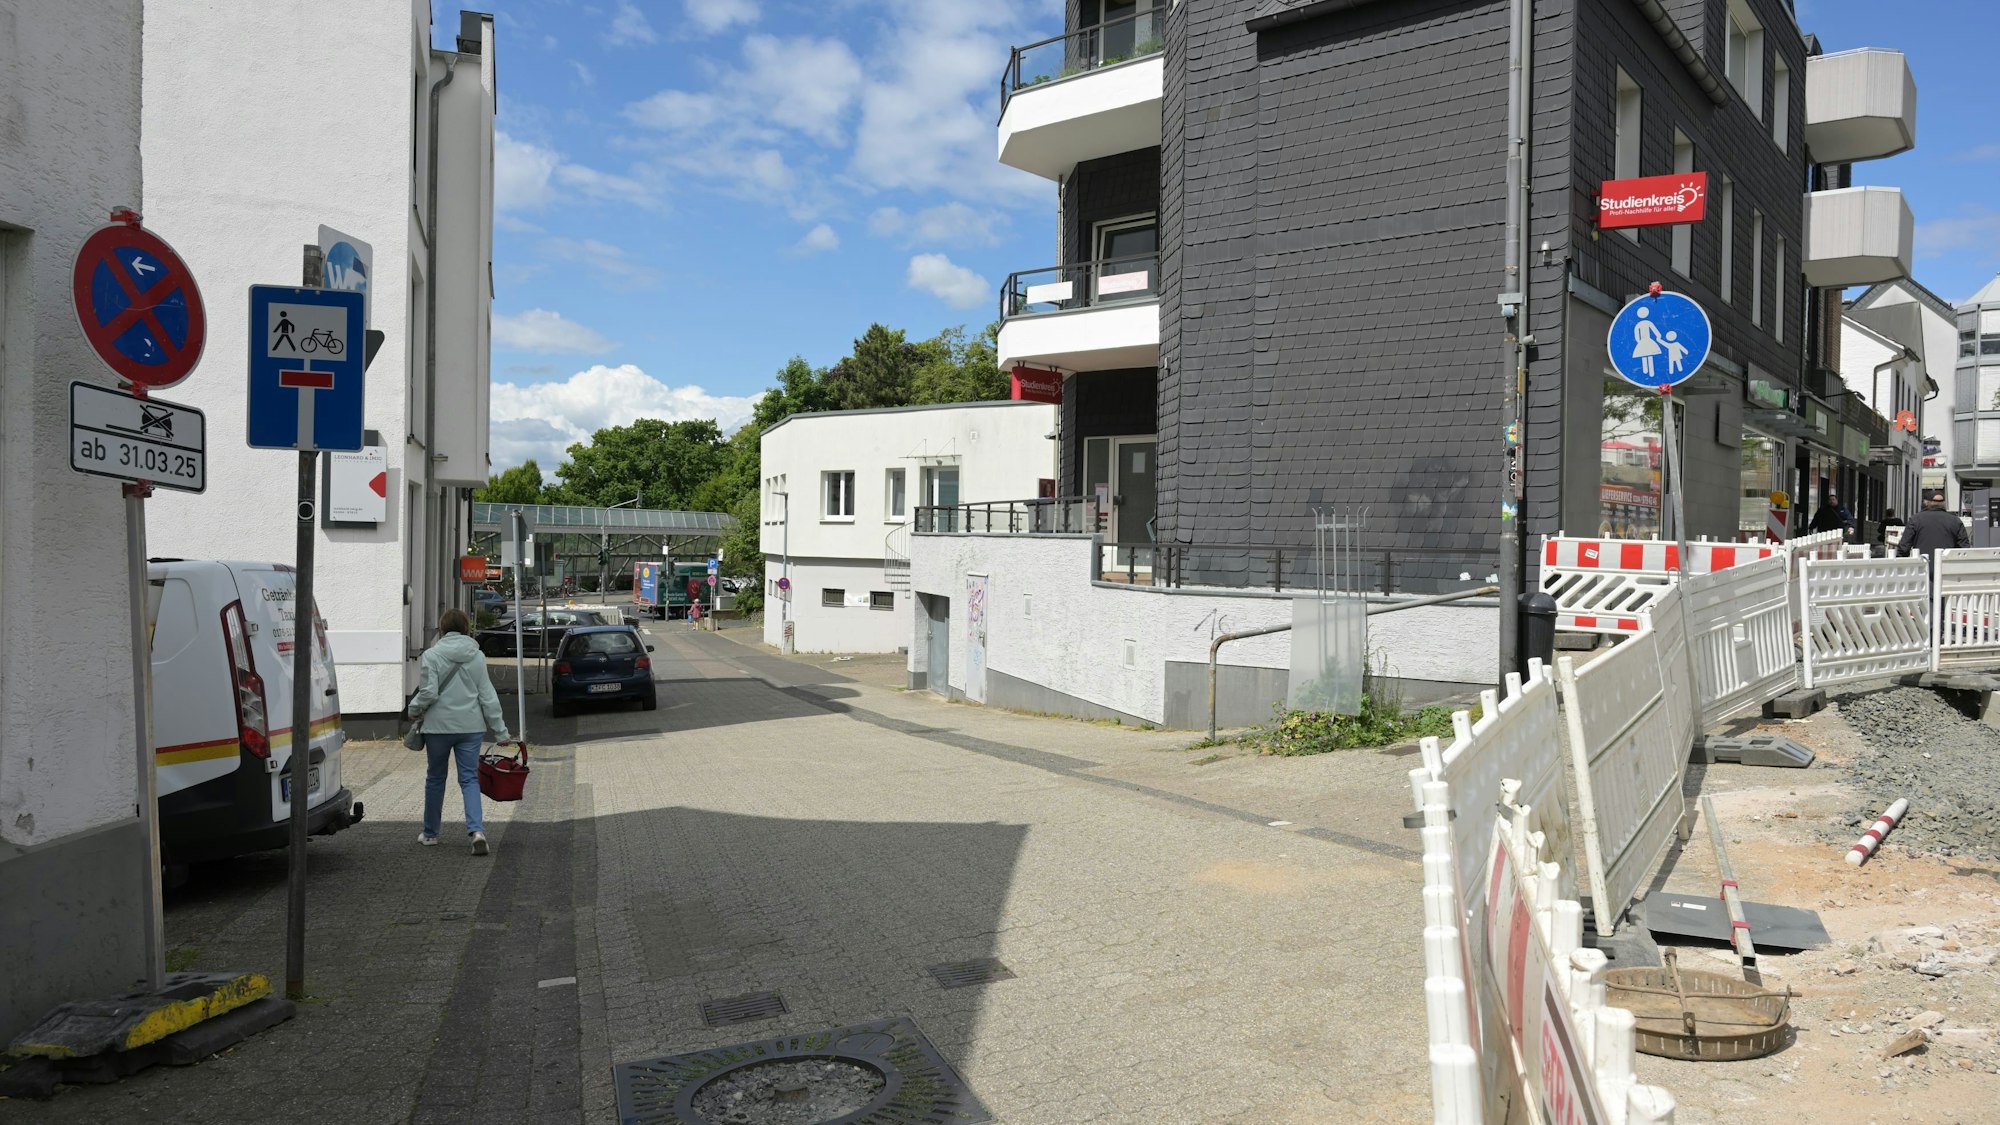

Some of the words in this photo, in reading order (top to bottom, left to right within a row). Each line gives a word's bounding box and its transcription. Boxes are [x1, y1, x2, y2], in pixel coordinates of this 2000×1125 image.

[1600, 192, 1685, 211] Studienkreis
[1609, 207, 1652, 216] Profi-Nachhilfe
[81, 437, 106, 461] ab
[119, 443, 196, 479] 31.03.25
[261, 587, 296, 602] Getränk
